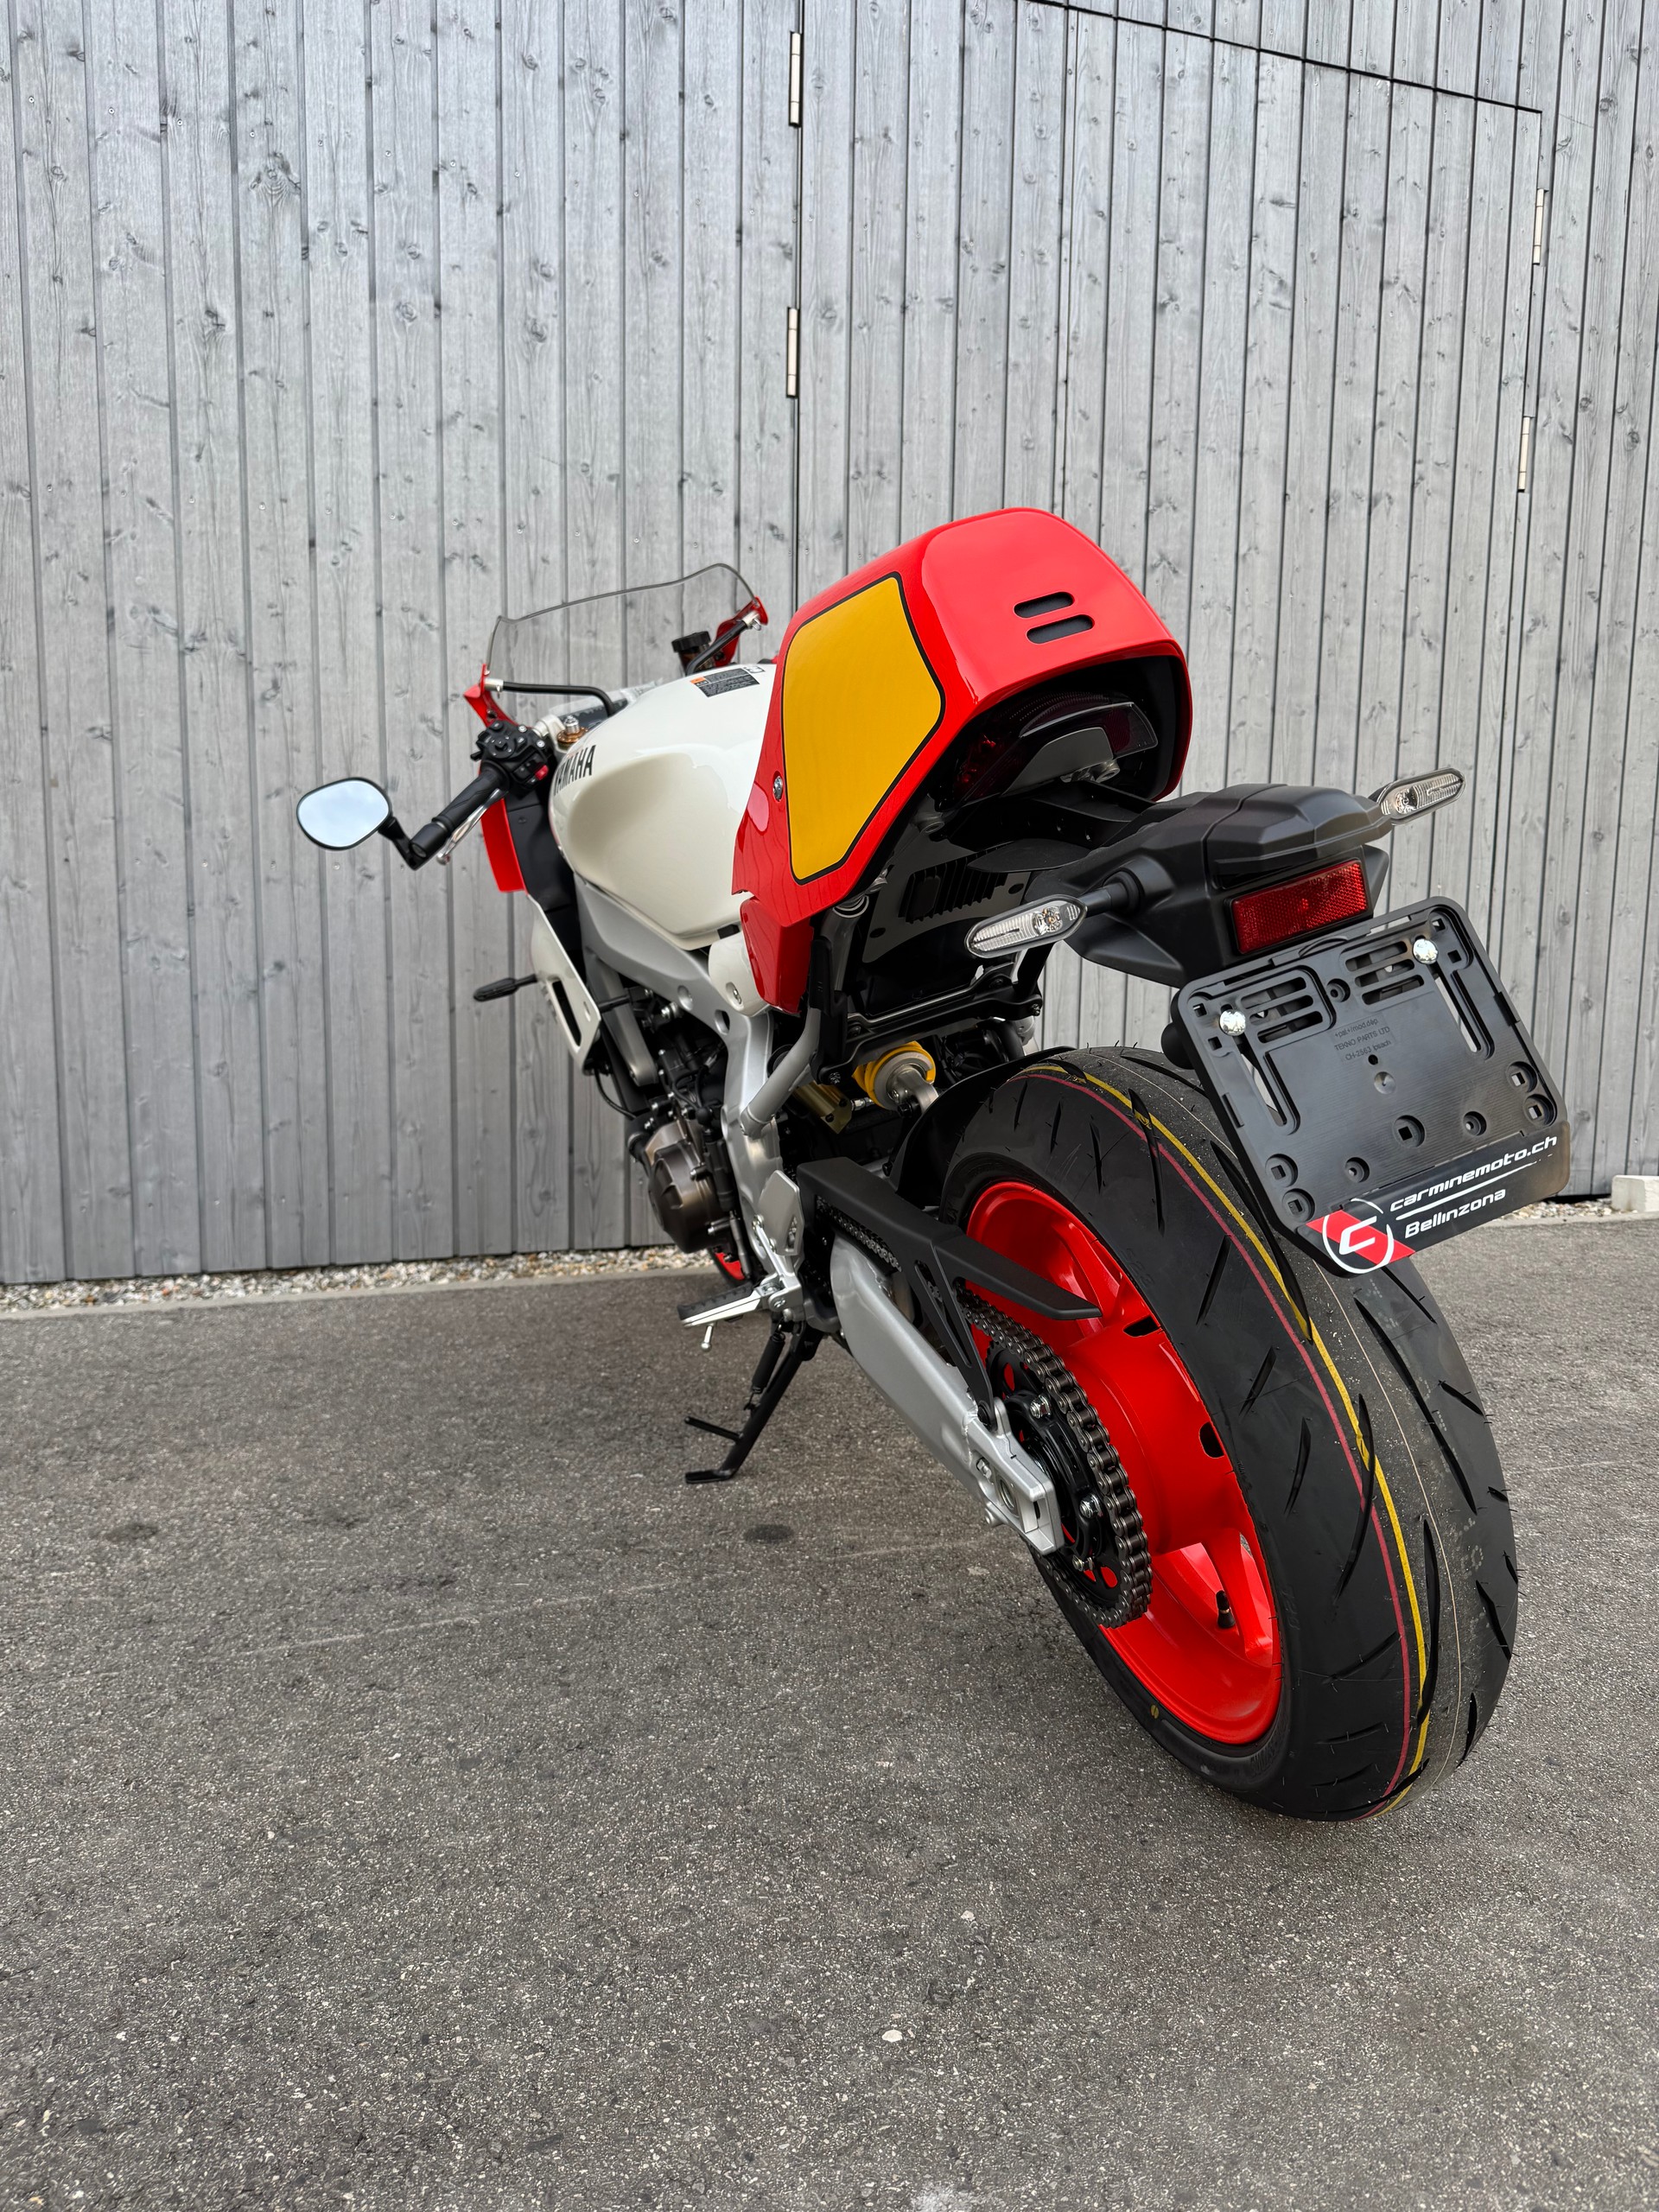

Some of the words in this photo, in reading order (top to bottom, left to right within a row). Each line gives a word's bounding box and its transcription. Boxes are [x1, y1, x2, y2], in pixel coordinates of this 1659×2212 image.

[554, 745, 596, 796] YAMAHA
[1334, 1039, 1357, 1051] TEKNO
[1357, 1031, 1378, 1043] PARTS
[1378, 1026, 1390, 1035] LTD
[1344, 1046, 1372, 1060] CH-2563
[1390, 1135, 1557, 1212] carminemoto.ch
[1404, 1189, 1506, 1239] Bellinzona
